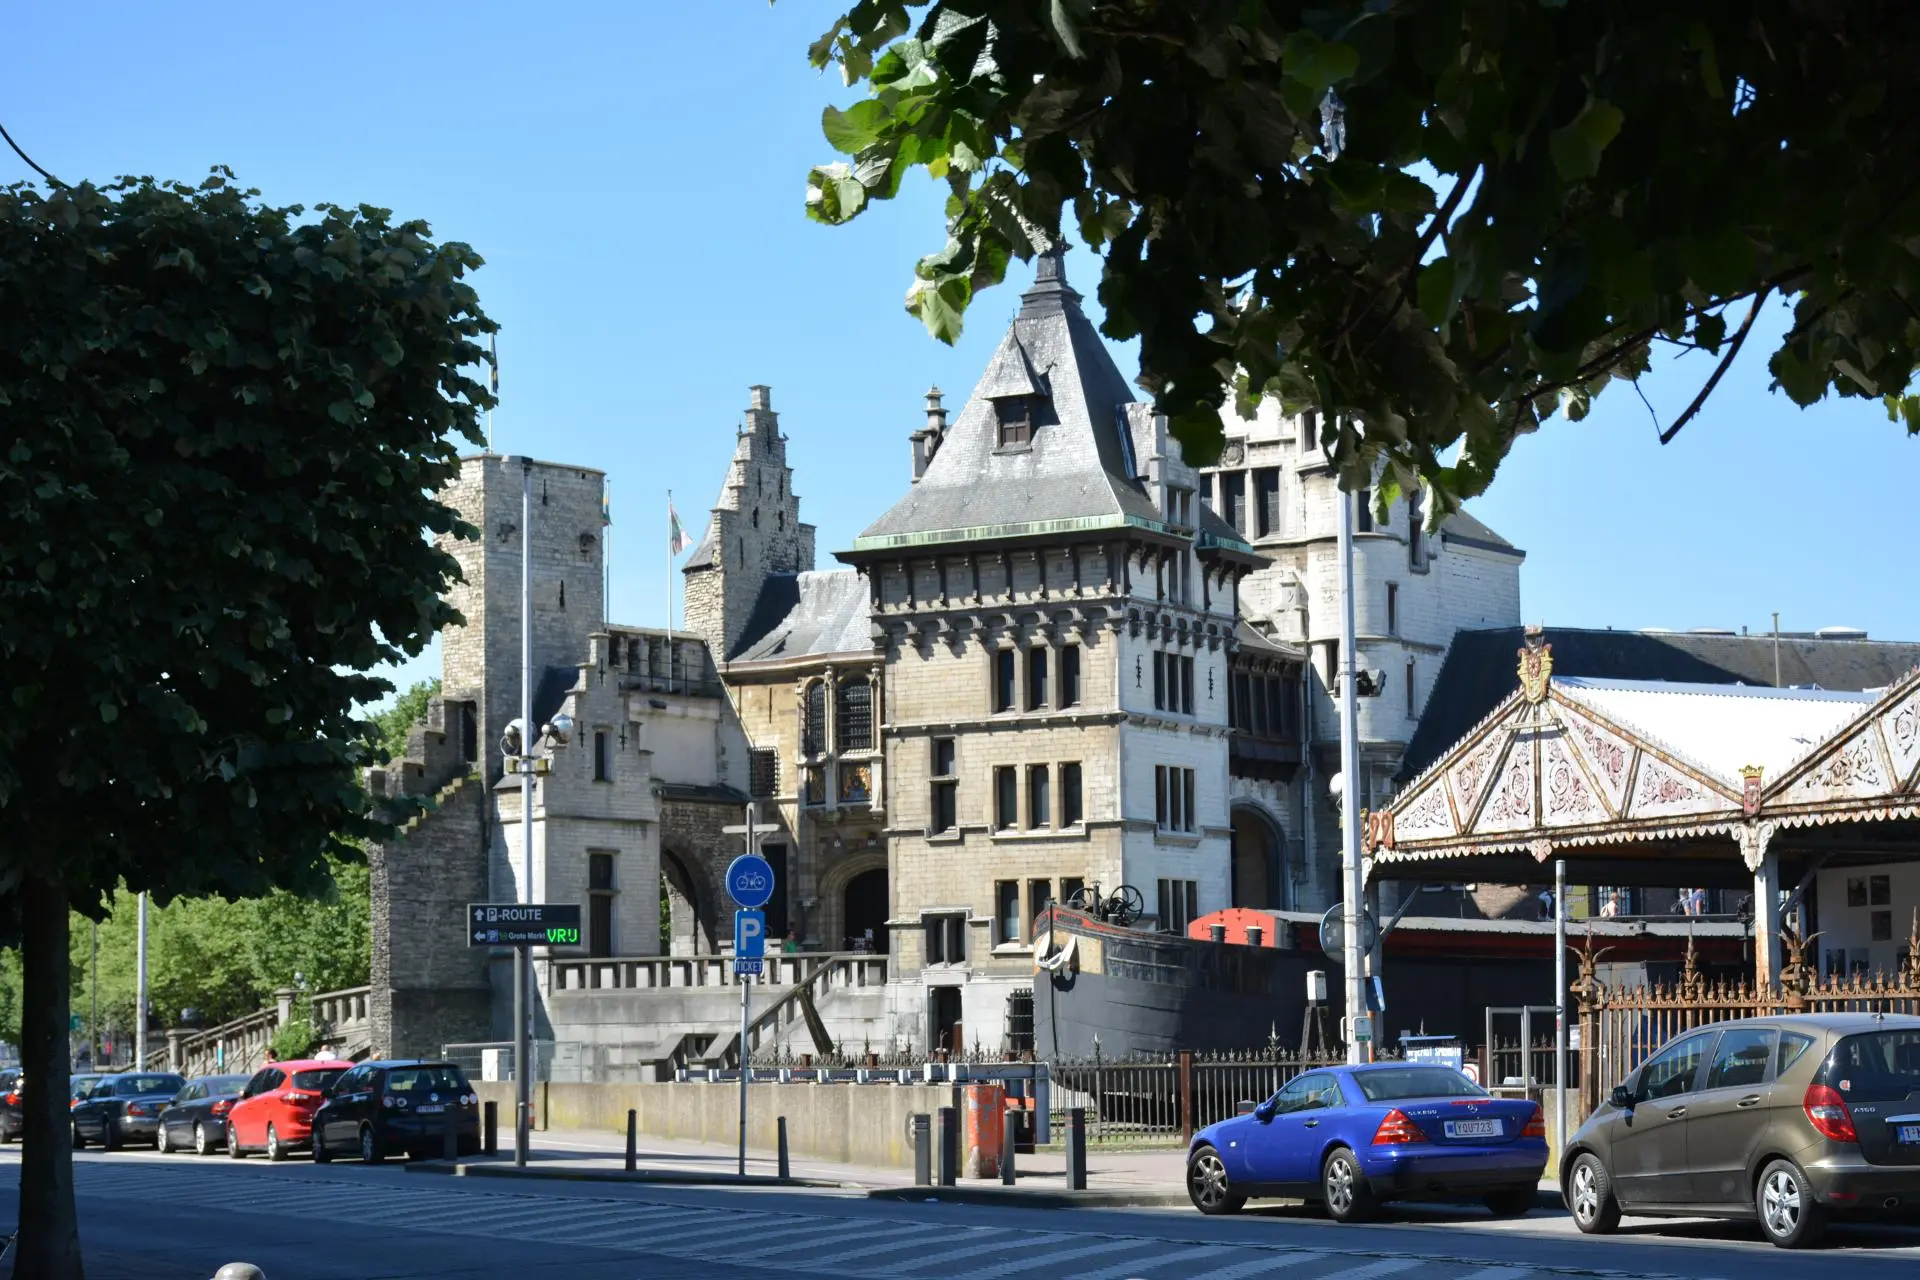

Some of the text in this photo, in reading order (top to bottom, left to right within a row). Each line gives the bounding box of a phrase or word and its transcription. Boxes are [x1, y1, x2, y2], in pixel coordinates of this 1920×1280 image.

[527, 931, 546, 940] Markt
[741, 918, 760, 950] P
[736, 961, 762, 972] TICKET
